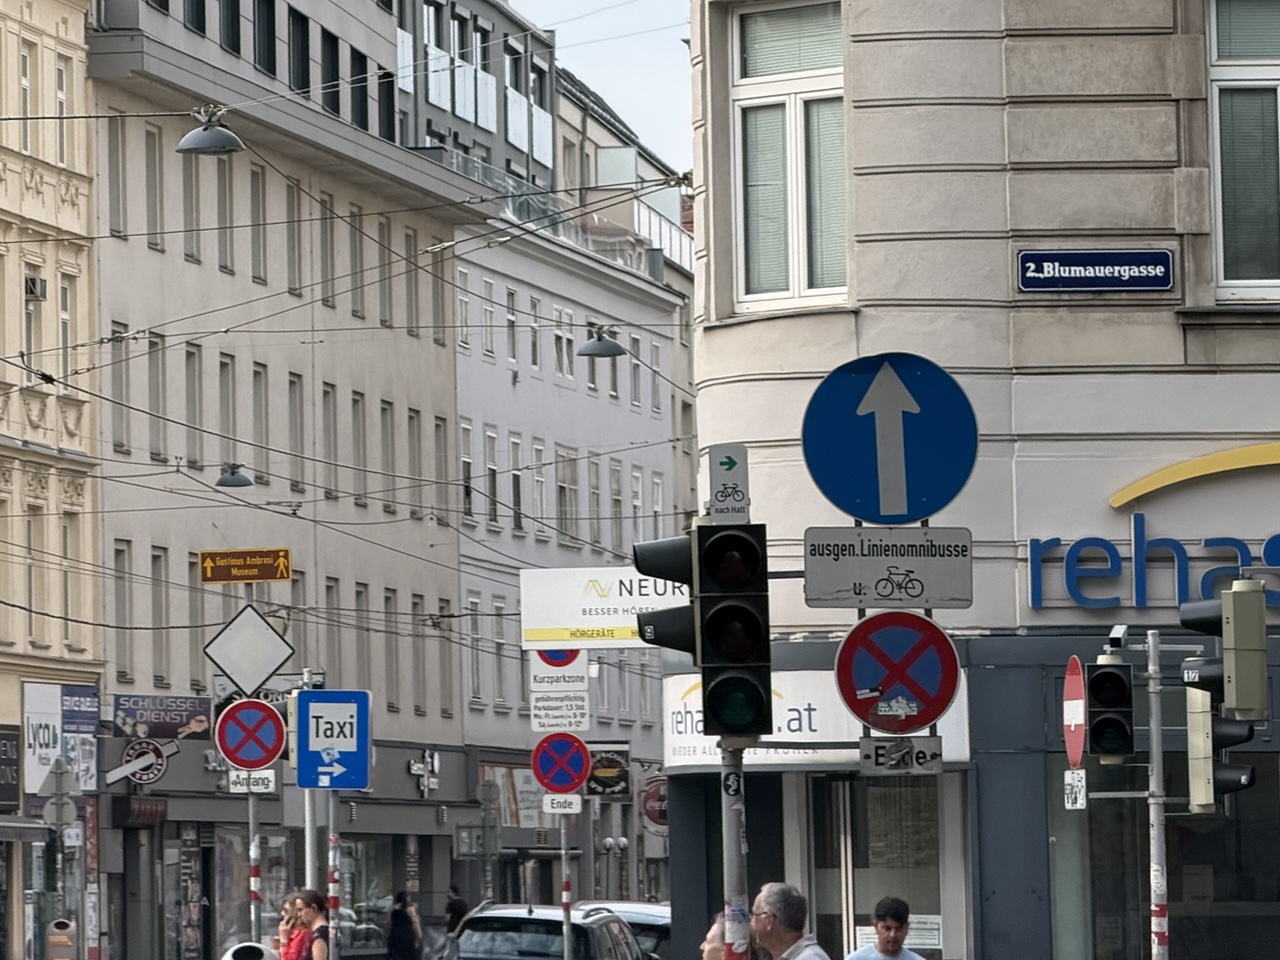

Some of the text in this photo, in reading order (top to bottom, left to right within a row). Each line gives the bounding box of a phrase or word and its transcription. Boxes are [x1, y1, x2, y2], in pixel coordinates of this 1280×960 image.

[1043, 261, 1166, 281] Blumauergasse
[731, 506, 746, 514] Halt
[231, 567, 259, 576] Museum
[853, 582, 867, 596] u.
[582, 607, 619, 616] BESSER
[570, 628, 615, 639] HÖRGERÄTE
[533, 675, 585, 685] Kurzparkzone
[120, 696, 207, 711] SCHLÜSSEL-
[136, 711, 190, 723] DIENST
[311, 714, 355, 739] Taxi
[551, 799, 573, 809] Ende
